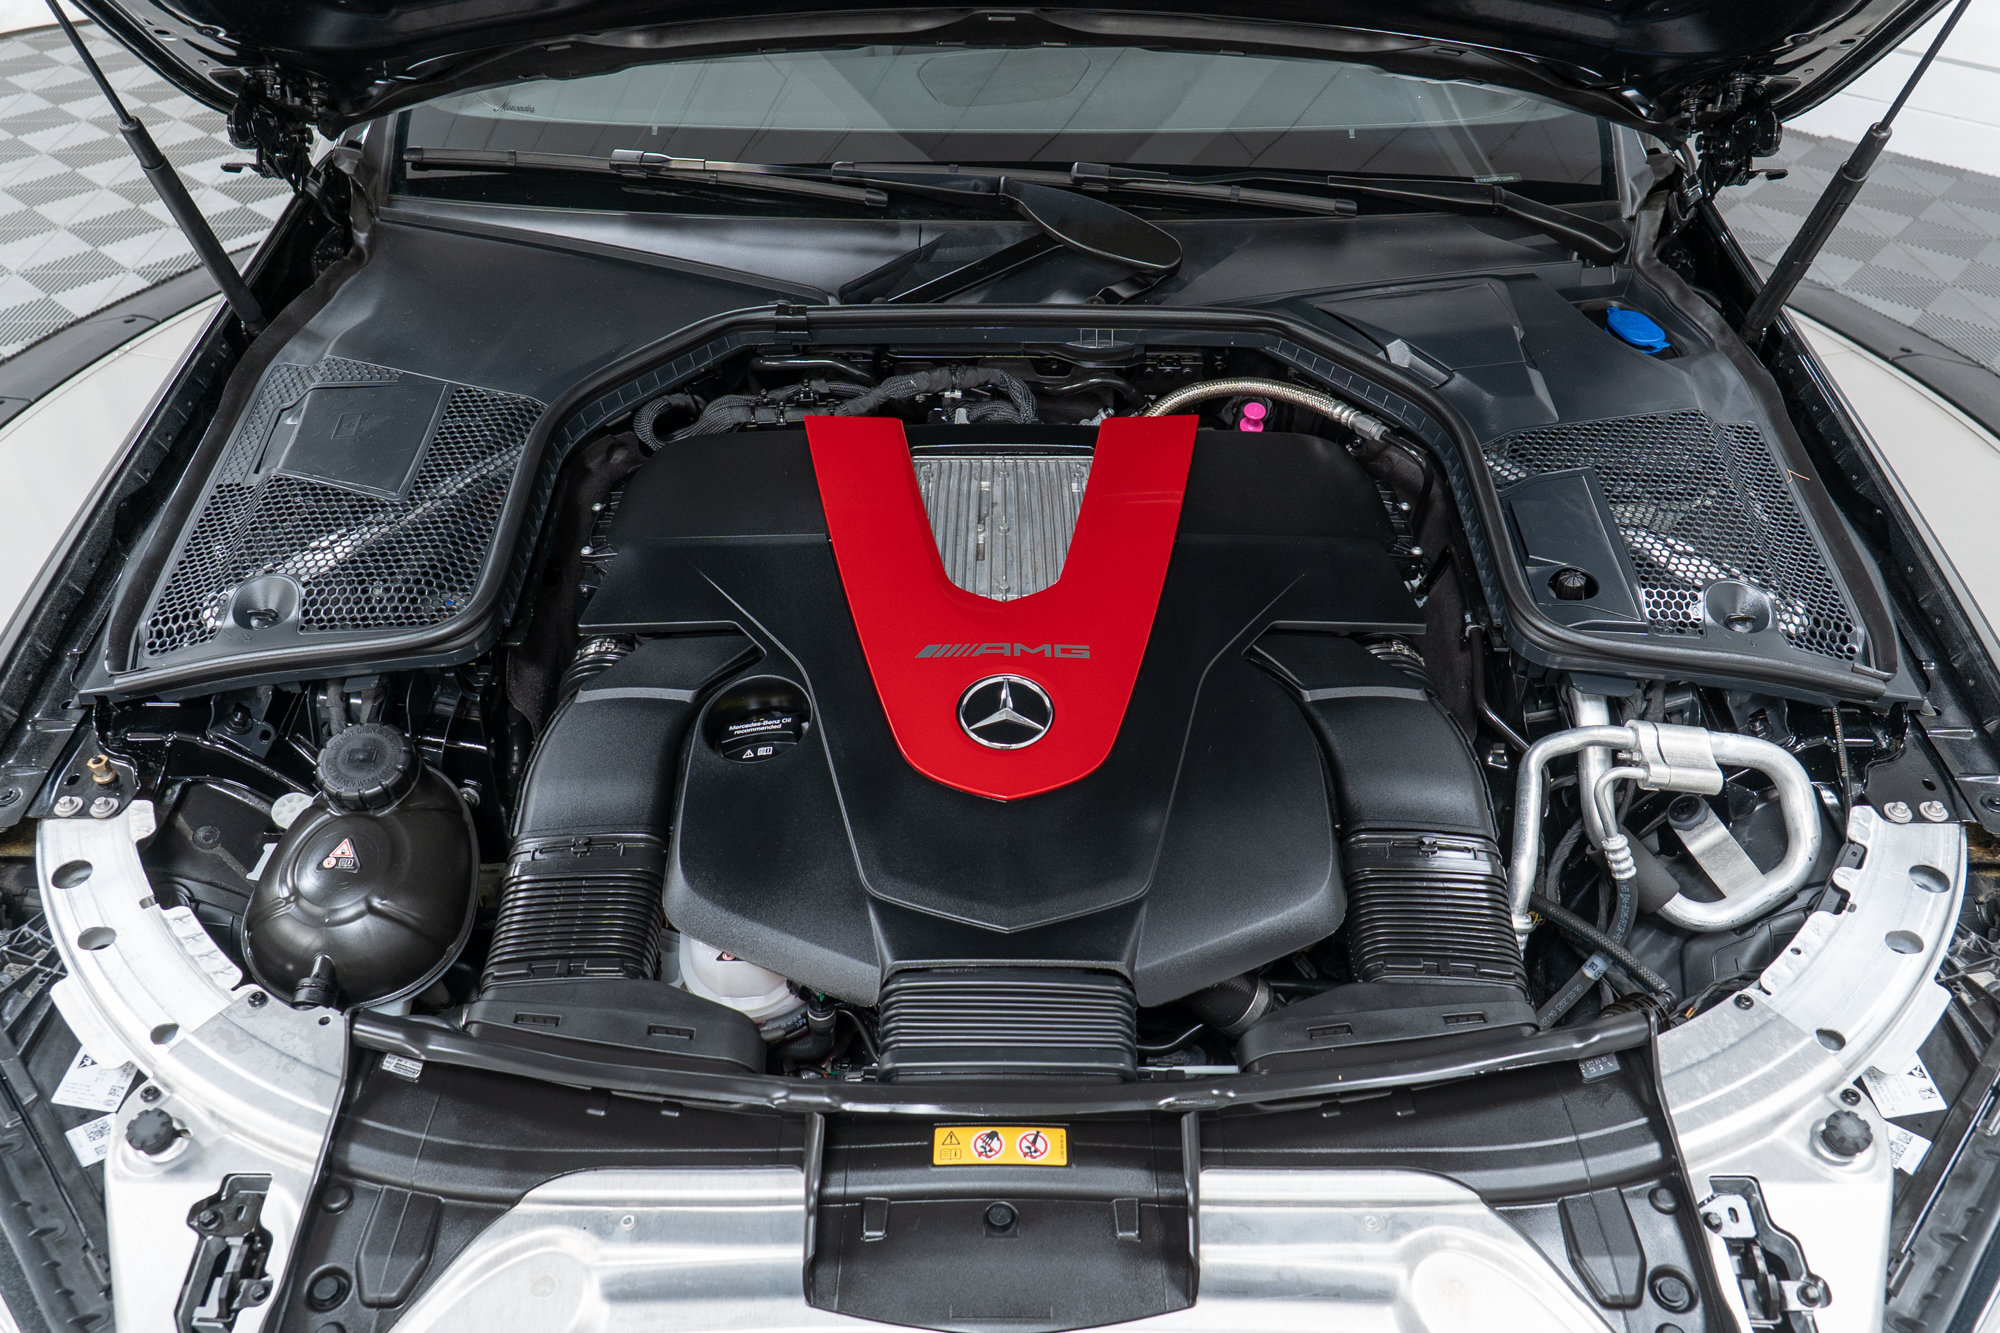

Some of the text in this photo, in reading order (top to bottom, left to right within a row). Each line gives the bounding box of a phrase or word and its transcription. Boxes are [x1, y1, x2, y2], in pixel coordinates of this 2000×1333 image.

[493, 101, 536, 113] Mercedes
[972, 642, 1091, 659] AMG
[729, 719, 780, 731] Mercedes-Benz
[733, 724, 782, 735] recommended
